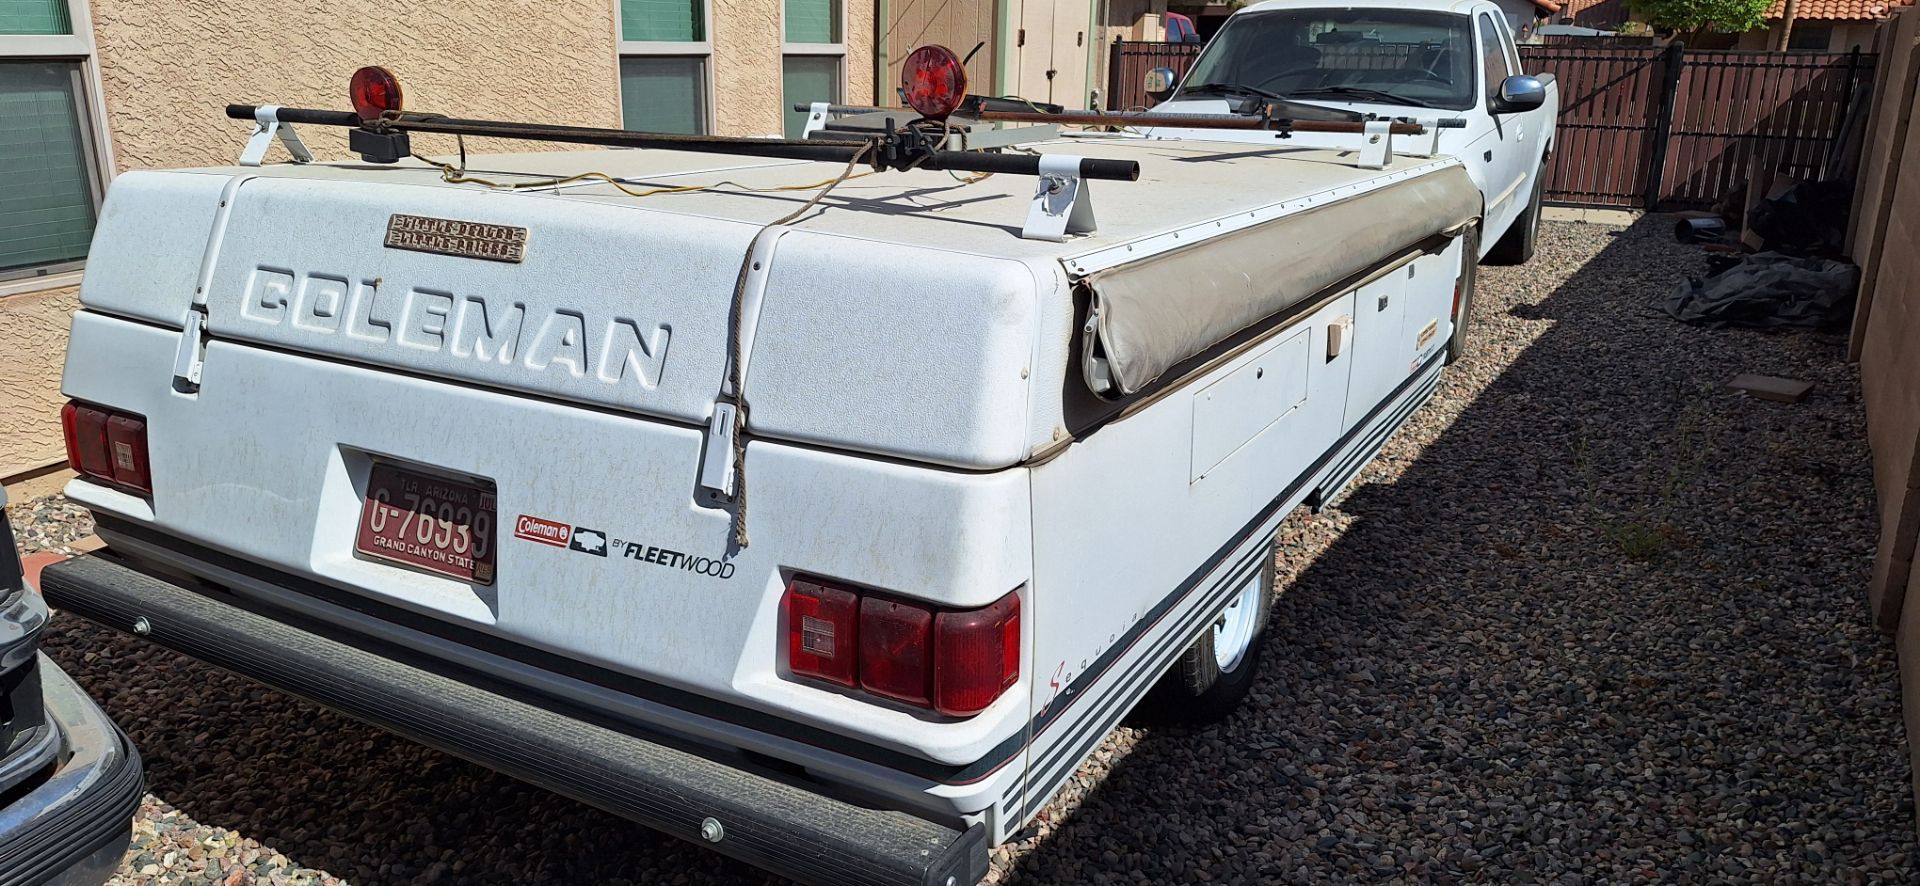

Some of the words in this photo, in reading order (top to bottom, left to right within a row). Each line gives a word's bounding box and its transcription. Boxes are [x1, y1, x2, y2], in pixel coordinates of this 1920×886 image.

[399, 231, 450, 248] LITTLE
[456, 239, 509, 256] PRICES
[401, 217, 452, 233] LITTLE
[458, 223, 514, 240] DEALER
[240, 264, 673, 391] COLEMAN
[426, 485, 469, 505] ARIZONA
[370, 487, 490, 559] G-76939
[373, 535, 405, 552] GRAND
[407, 543, 446, 562] CANYON
[447, 554, 476, 570] STATE
[518, 516, 558, 538] Coleman
[612, 538, 628, 548] BY
[624, 542, 735, 580] FLEETWOOD
[1040, 612, 1138, 718] Sequoia
